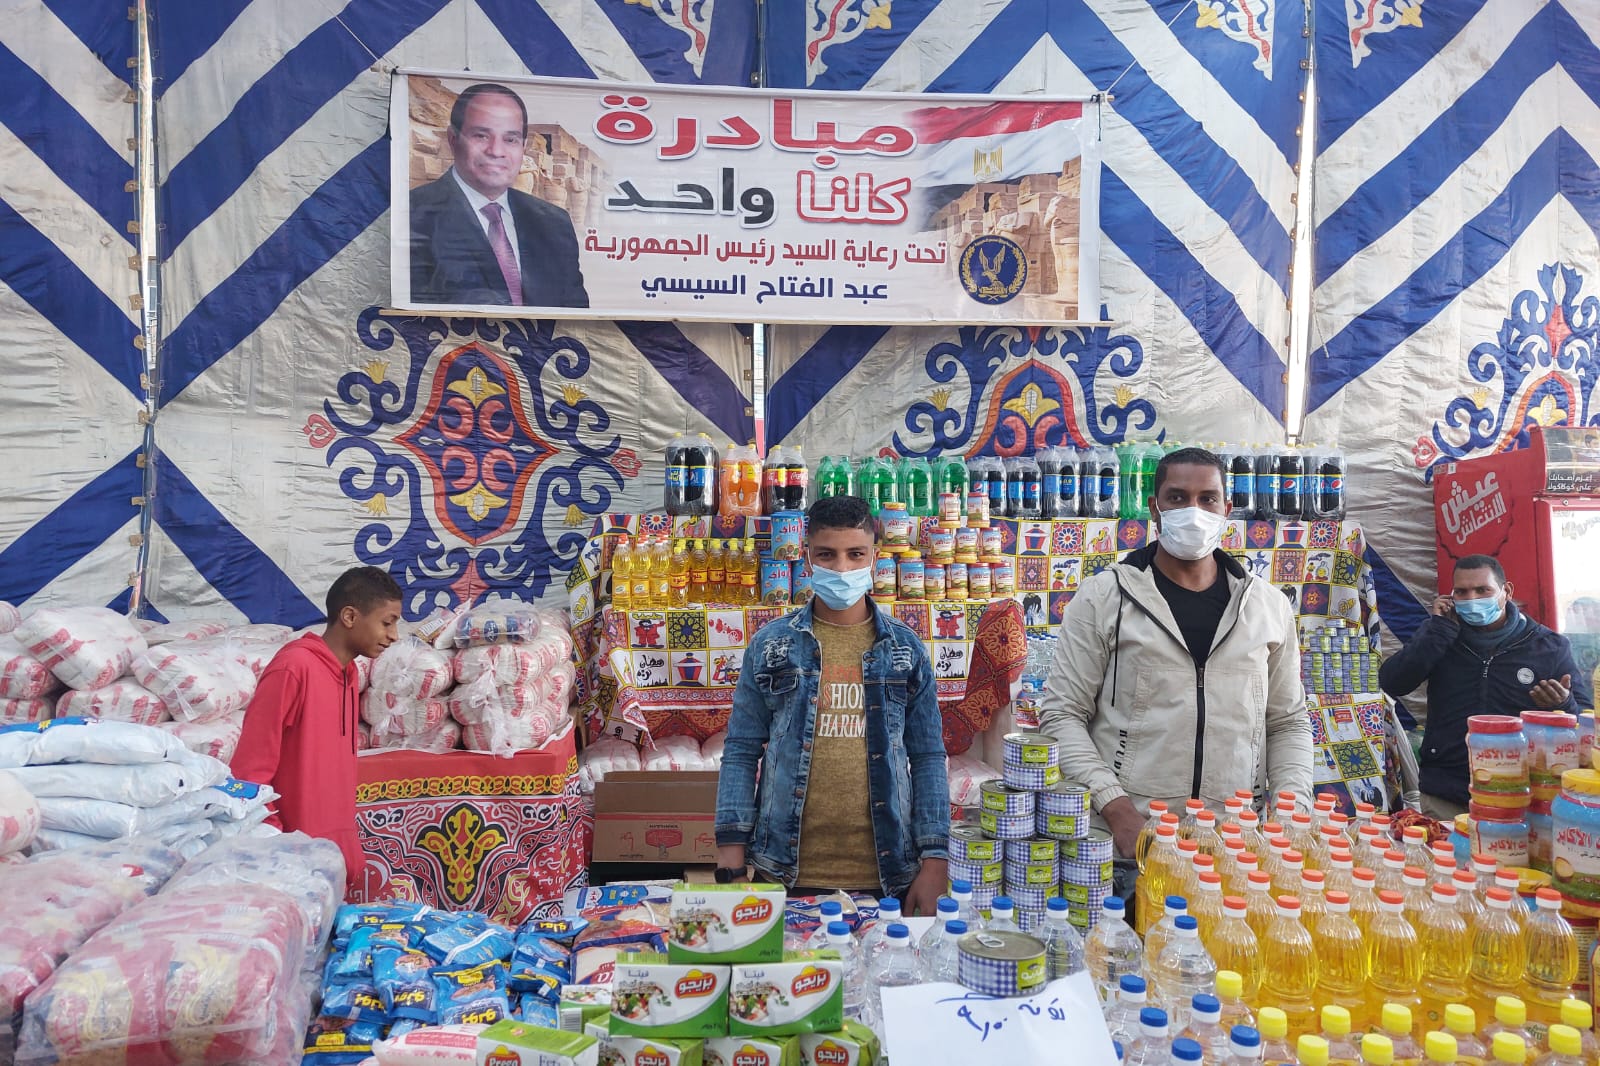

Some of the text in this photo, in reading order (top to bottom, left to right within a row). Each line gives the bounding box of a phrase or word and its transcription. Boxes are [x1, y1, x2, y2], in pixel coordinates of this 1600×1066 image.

[594, 94, 917, 168] مبادرة
[606, 166, 911, 227] كلنا واحد
[585, 229, 947, 270] تحت رعاية السيد رئيس الجمهورية
[641, 274, 888, 304] عبد الفتاح السيسي
[1441, 472, 1499, 534] عيش
[735, 903, 769, 922] بريجو
[678, 977, 714, 994] بريجو
[794, 972, 827, 994] بريجو
